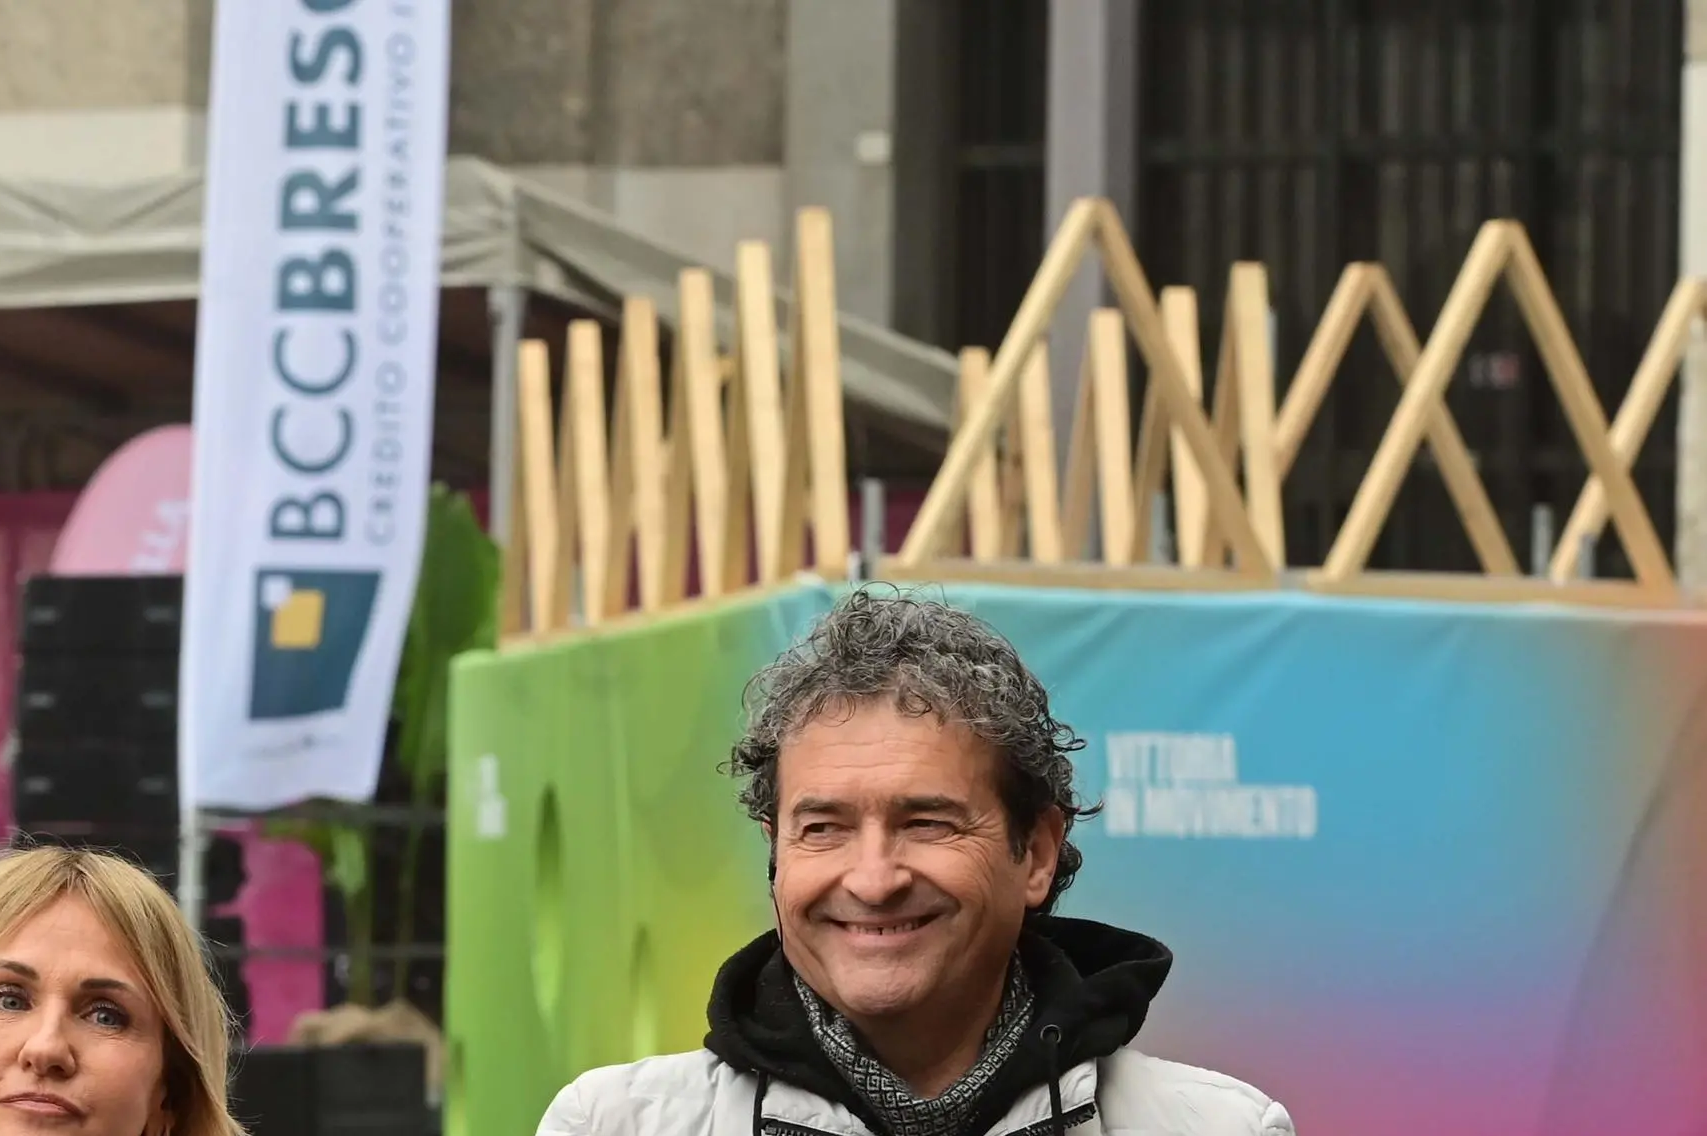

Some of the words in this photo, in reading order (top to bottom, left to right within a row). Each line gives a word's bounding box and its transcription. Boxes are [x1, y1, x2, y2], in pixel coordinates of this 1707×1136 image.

[270, 0, 364, 538] BCCBRES
[377, 33, 418, 347] COOPERATIVO
[365, 361, 408, 546] CREDITO
[1105, 731, 1237, 782] VITTORIA
[1105, 785, 1139, 837] IN
[1144, 783, 1319, 838] MOVIMENTO
